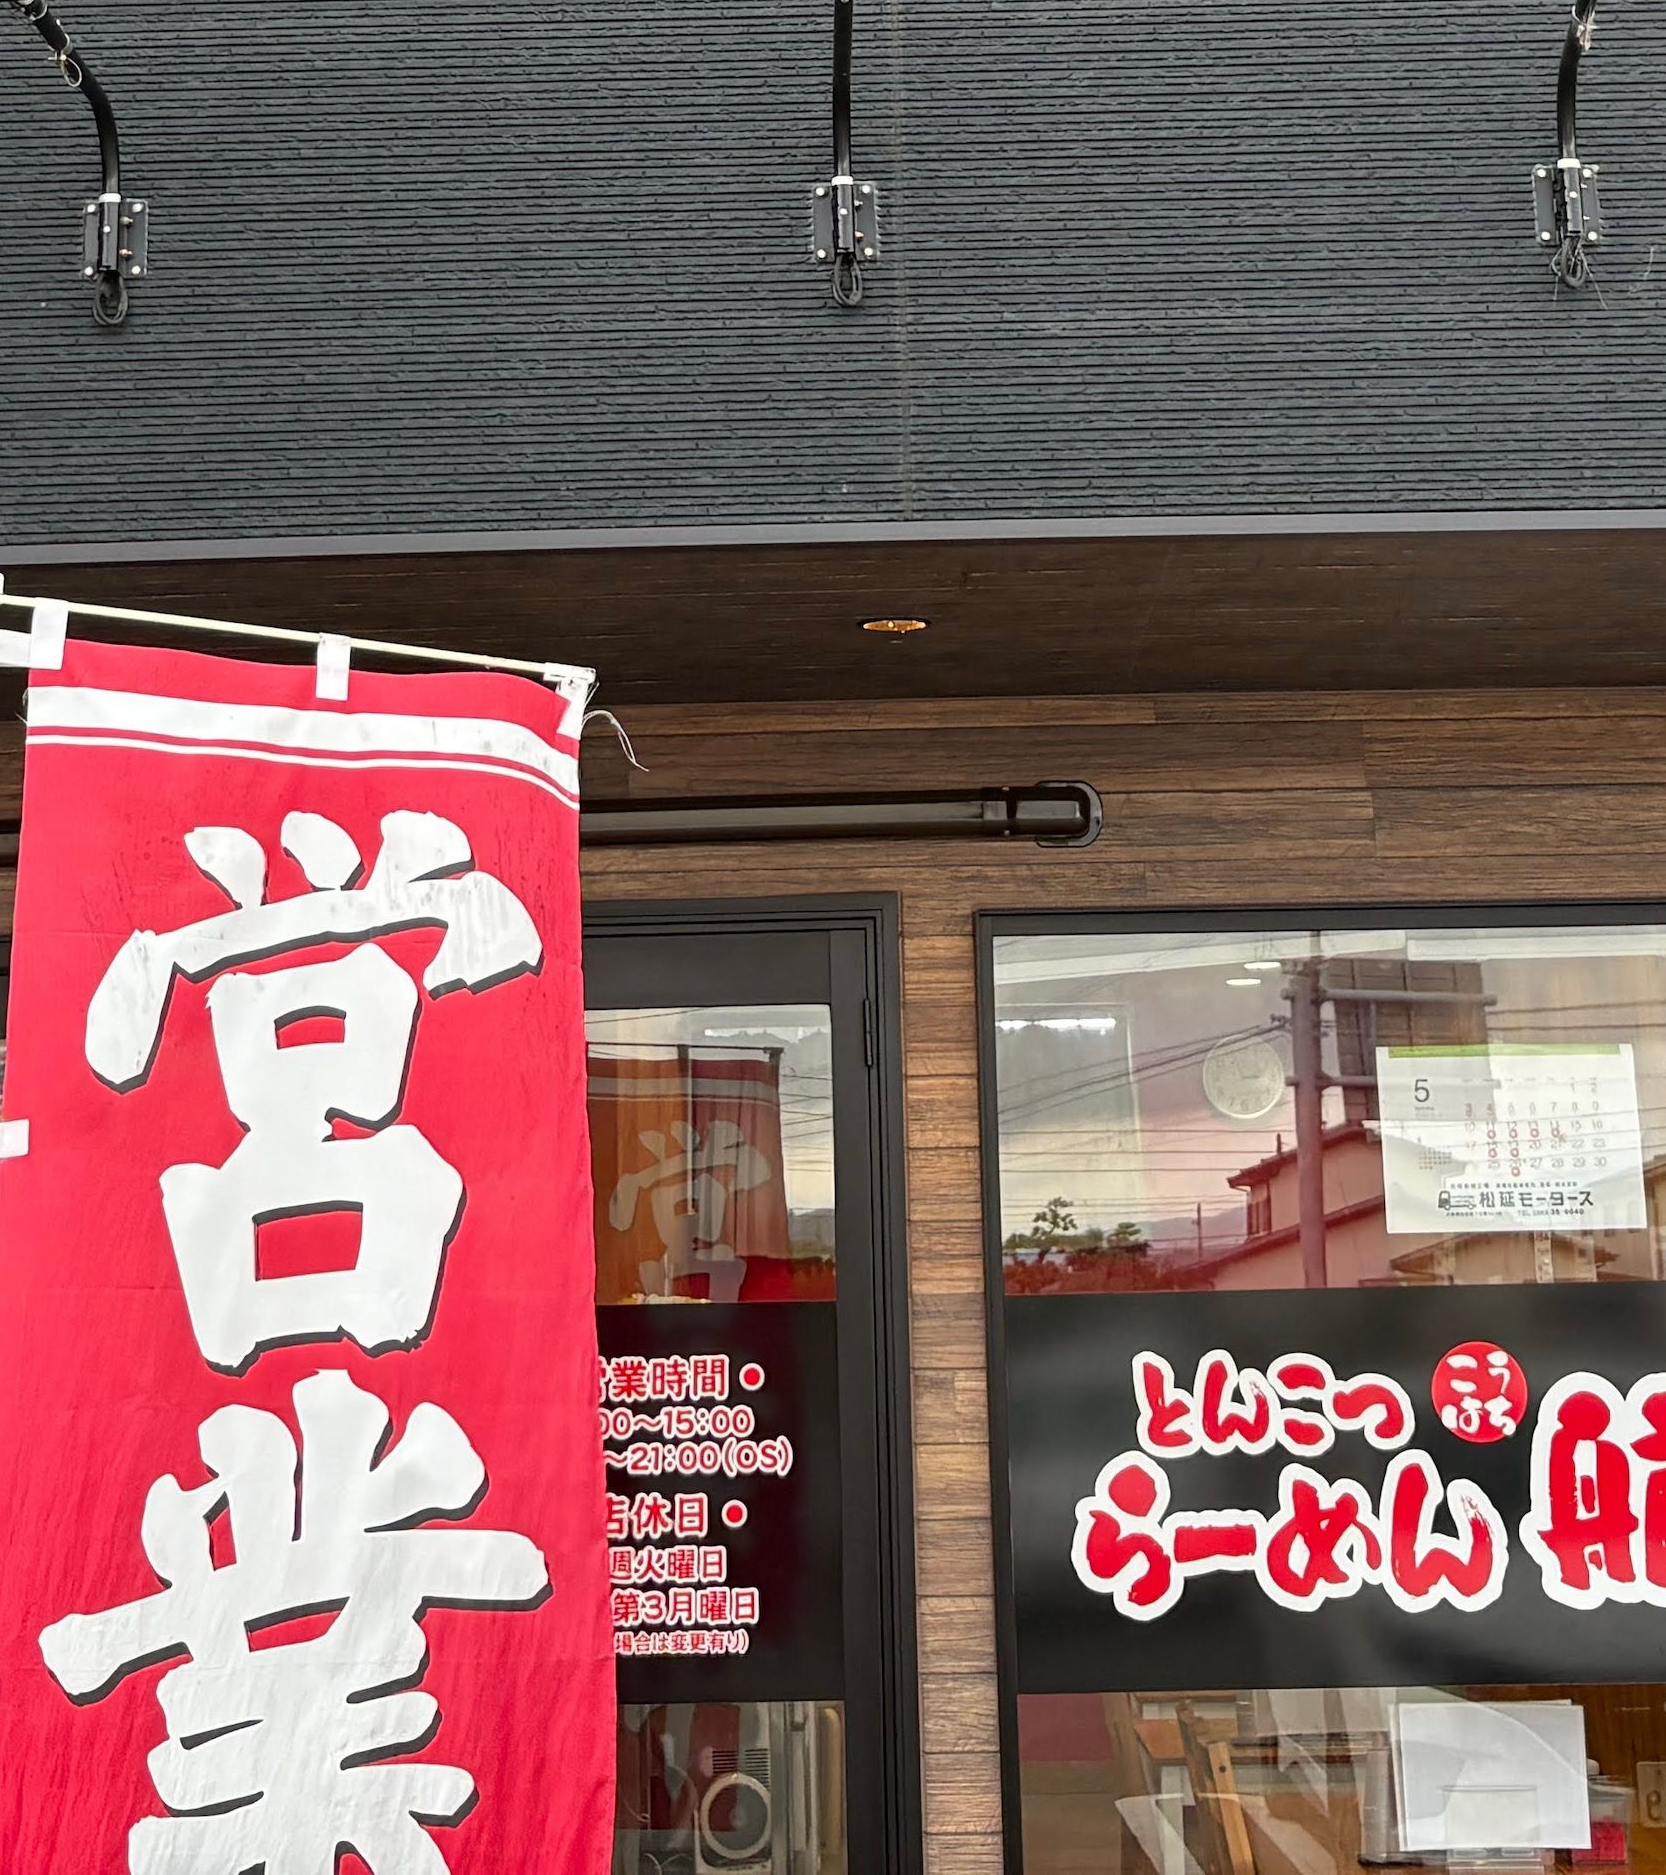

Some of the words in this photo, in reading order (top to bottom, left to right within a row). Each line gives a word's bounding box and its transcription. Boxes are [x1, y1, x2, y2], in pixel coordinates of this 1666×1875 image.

[1414, 1078, 1430, 1103] 5
[38, 810, 555, 1875] 営業
[1137, 1353, 1410, 1453] とんこつ
[1078, 1455, 1501, 1615] らーめん
